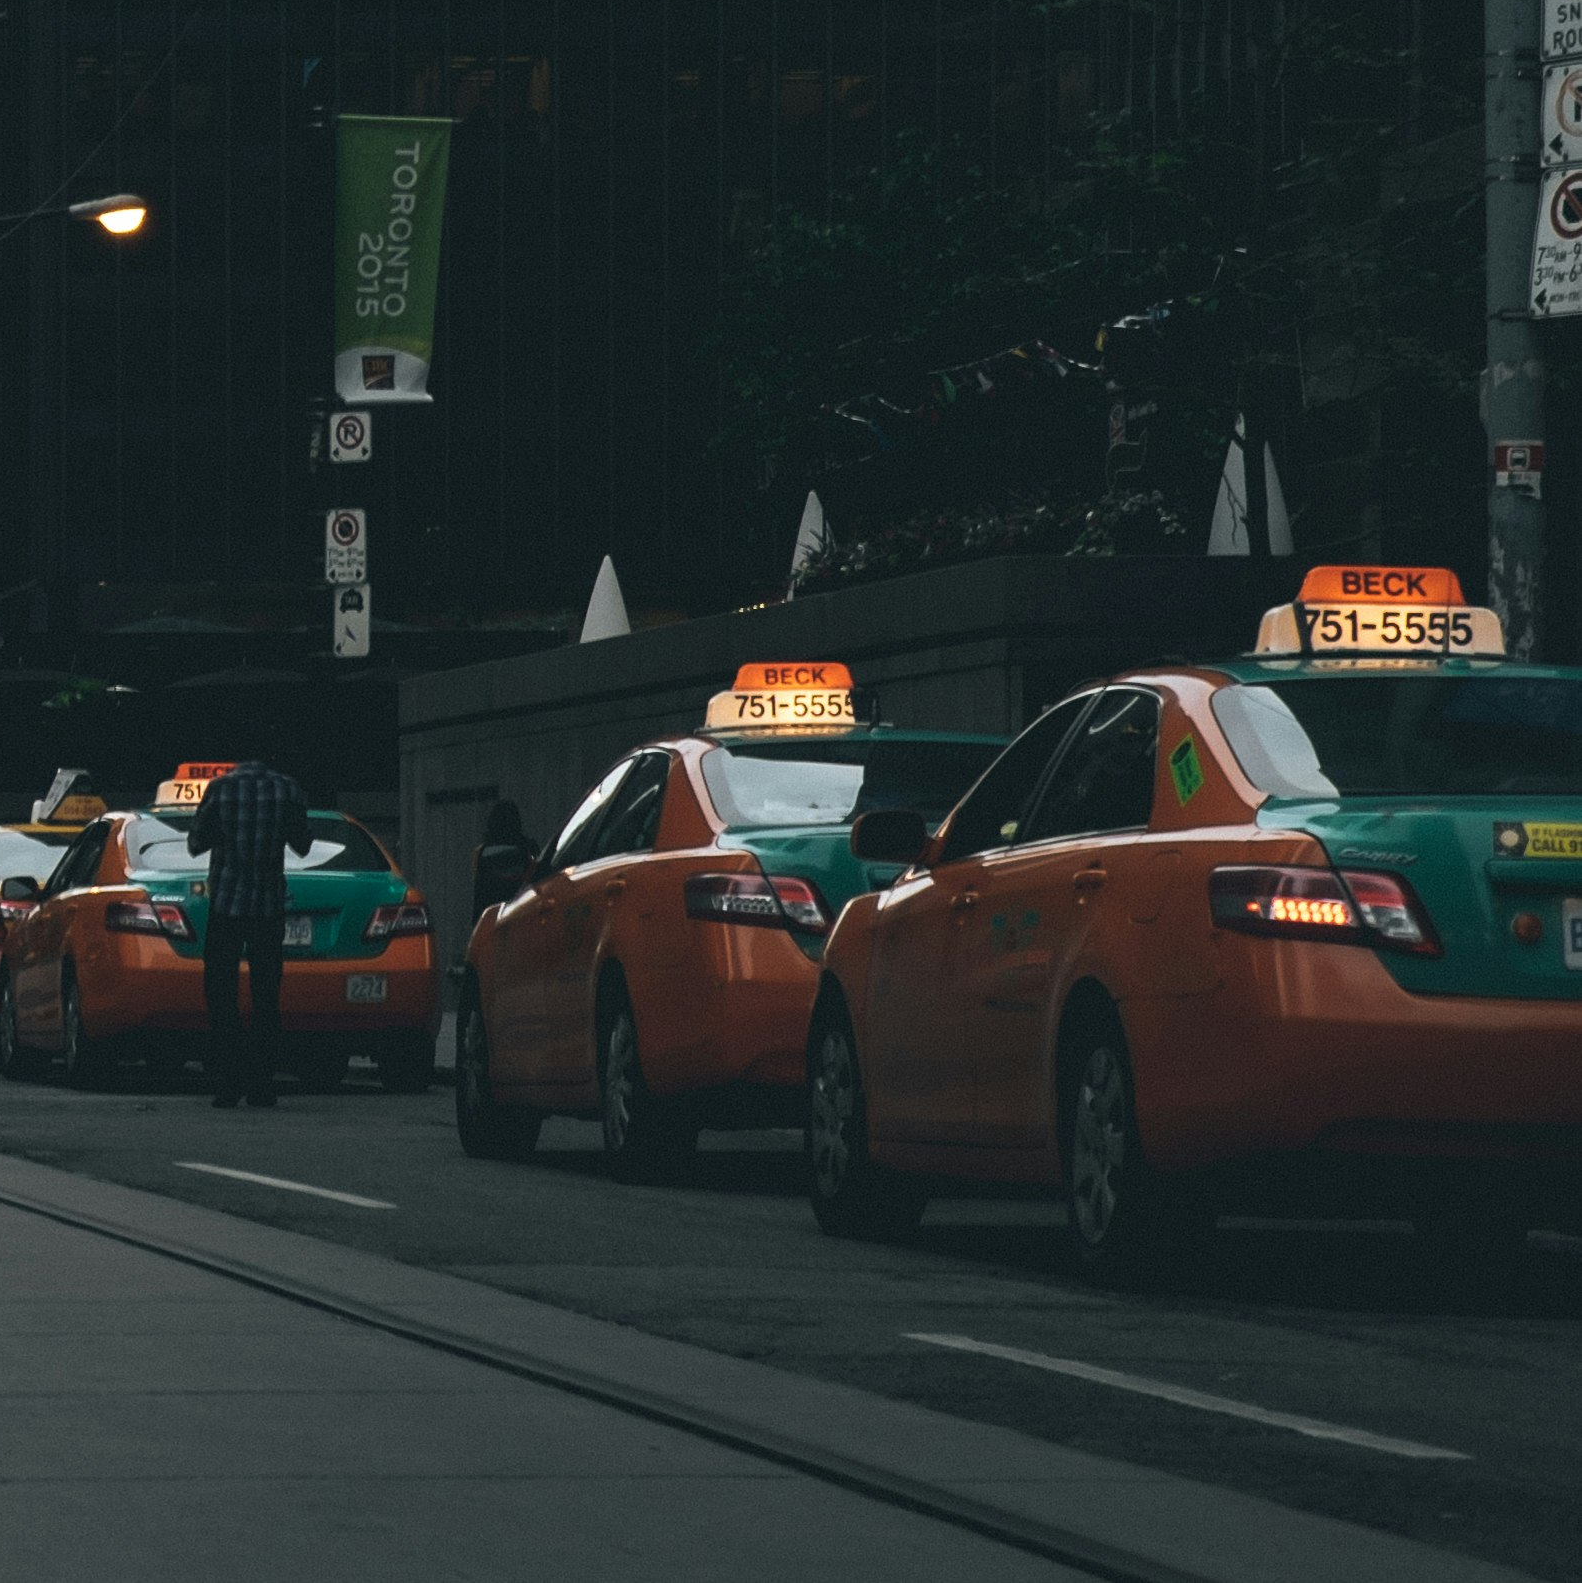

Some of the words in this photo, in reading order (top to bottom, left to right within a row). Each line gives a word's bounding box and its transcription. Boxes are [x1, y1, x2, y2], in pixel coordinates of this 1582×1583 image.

[382, 141, 420, 317] TORONTO
[356, 232, 383, 317] 2015
[1341, 571, 1426, 596] BECK
[1304, 609, 1473, 645] 751-5555
[764, 668, 827, 686] BECK
[735, 694, 854, 718] 751-5555
[1532, 839, 1565, 853] CALL
